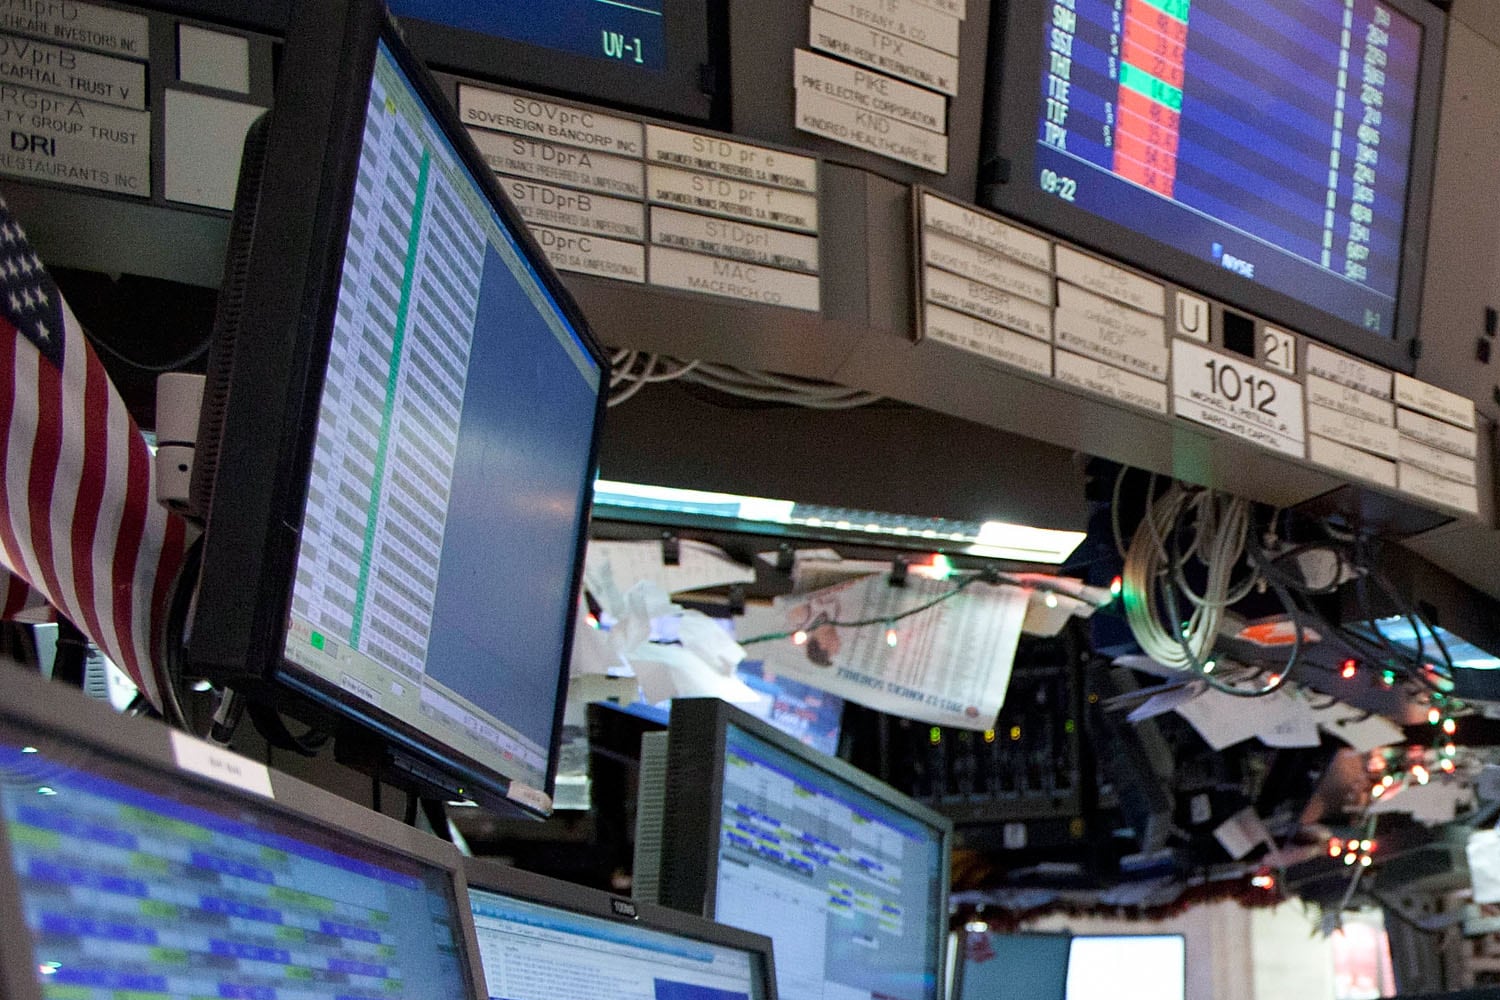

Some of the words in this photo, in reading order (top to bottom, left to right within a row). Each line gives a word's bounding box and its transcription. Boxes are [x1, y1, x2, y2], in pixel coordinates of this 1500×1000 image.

[54, 24, 117, 49] INVESTORS
[120, 40, 138, 52] INC
[869, 30, 904, 57] TPX
[0, 61, 60, 87] CAPITAL
[69, 76, 113, 97] TRUST
[120, 87, 129, 100] V
[854, 71, 889, 96] PIKE
[513, 98, 594, 128] SOVprC
[10, 131, 56, 157] DRI
[32, 115, 83, 134] GROUP
[90, 126, 136, 145] TRUST
[468, 108, 545, 133] SOVEREIGN
[549, 125, 612, 146] BANCORP
[617, 141, 637, 153] INC
[513, 139, 592, 168] STDprA
[692, 136, 732, 158] STD
[115, 173, 138, 189] INC
[512, 183, 592, 211] STDprB
[713, 260, 757, 283] MAC
[1180, 299, 1199, 333] U
[1264, 334, 1290, 369] 21
[1205, 359, 1277, 417] 1012
